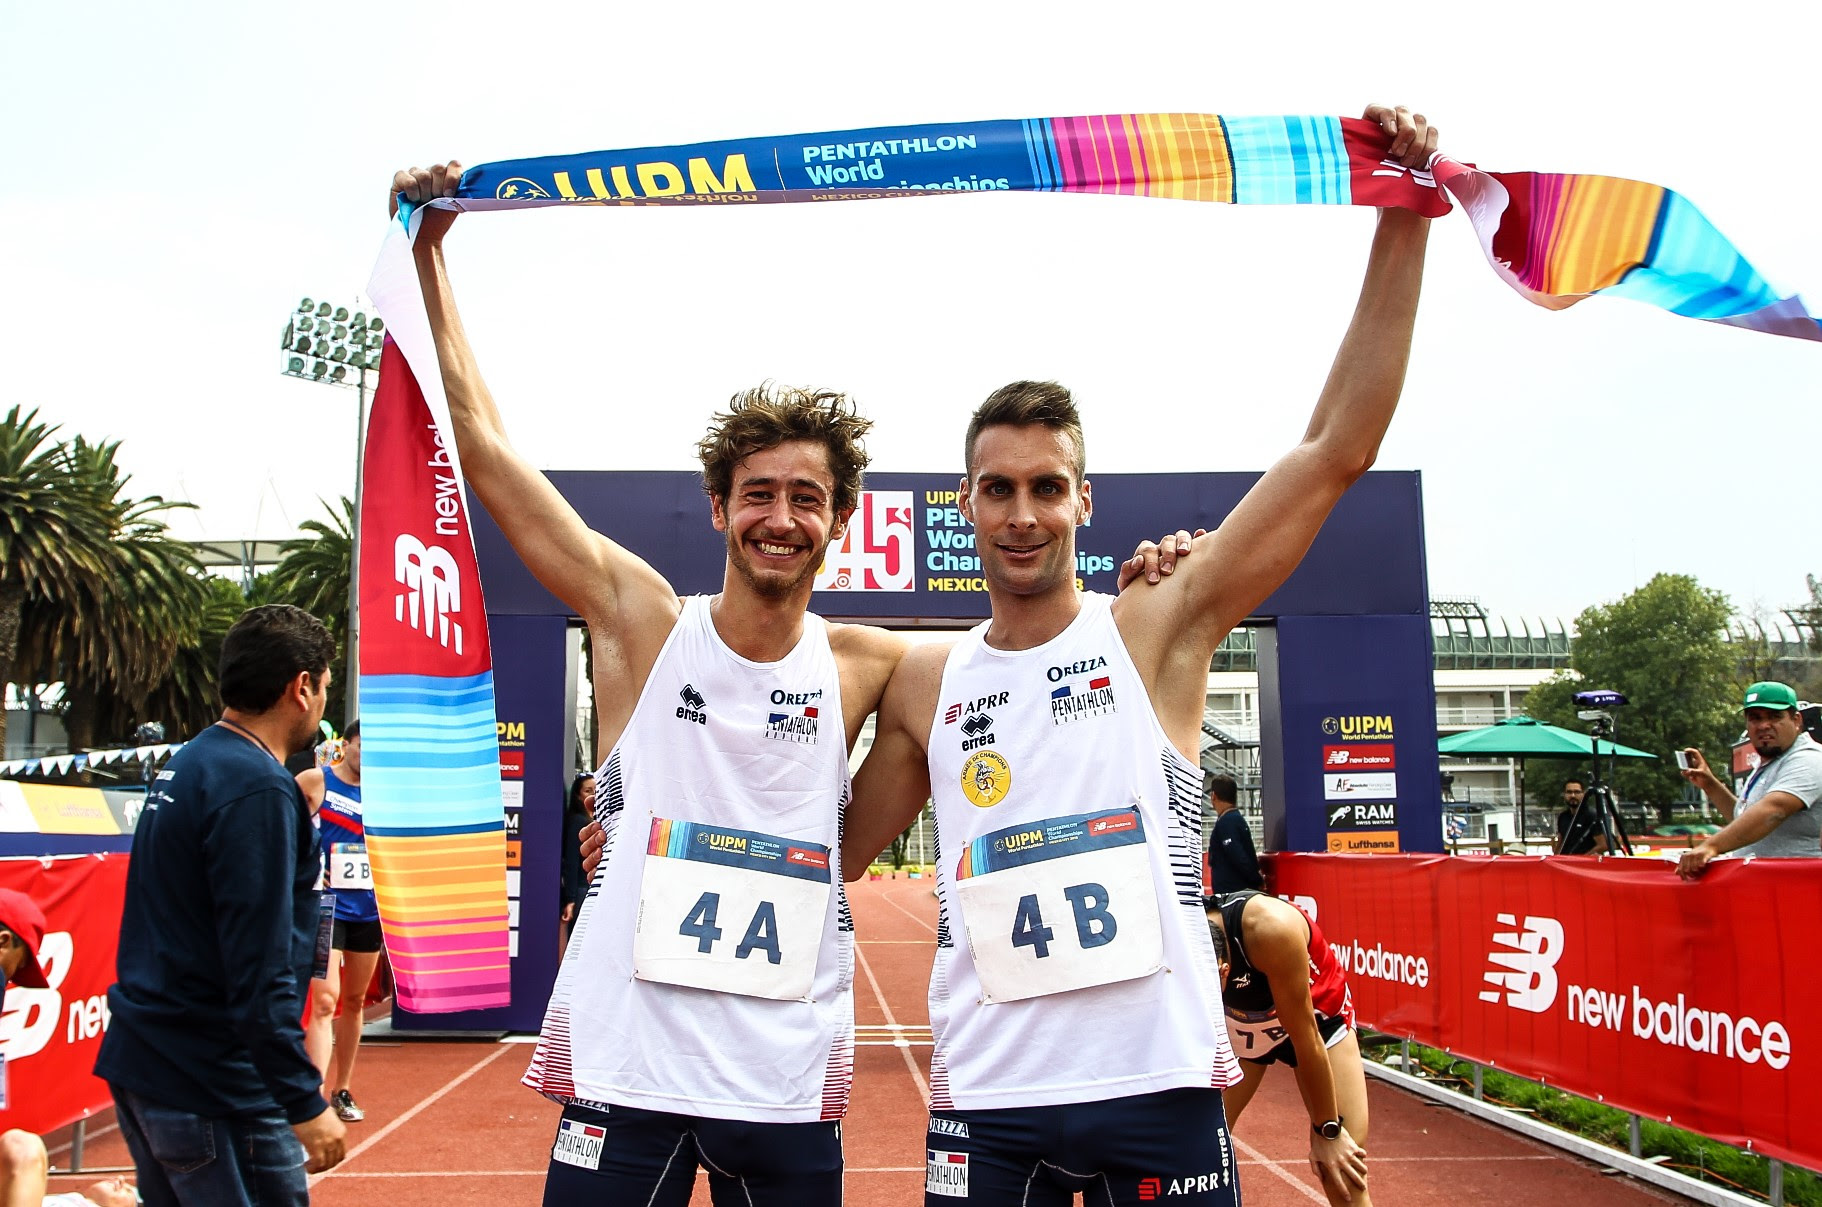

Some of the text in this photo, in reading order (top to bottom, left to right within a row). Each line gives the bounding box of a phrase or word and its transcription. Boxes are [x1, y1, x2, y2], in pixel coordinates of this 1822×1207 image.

[803, 134, 977, 163] PENTATHLON
[805, 158, 884, 186] World
[435, 474, 459, 535] new
[925, 490, 960, 505] UIP
[925, 529, 976, 549] Wor
[1046, 655, 1108, 683] OREZZA
[964, 691, 1010, 716] APRR
[1051, 687, 1115, 718] PENTATHLON
[496, 722, 525, 740] PM
[1340, 715, 1393, 734] UIPM
[961, 733, 995, 751] errea
[979, 752, 1007, 770] CHAMPIONS
[330, 802, 354, 816] System
[1354, 804, 1394, 819] RAM
[709, 834, 747, 850] UIPM
[1004, 830, 1044, 848] UIPM
[1020, 842, 1044, 850] Pentathlon
[1348, 840, 1395, 850] Lufthansa
[722, 846, 746, 854] Pentathlon
[343, 862, 370, 879] 2 B
[679, 891, 722, 954] 4
[735, 901, 782, 965] A
[1012, 894, 1054, 959] 4
[1064, 882, 1118, 950] B
[1354, 938, 1429, 988] balance
[1568, 984, 1626, 1032] new
[1632, 985, 1791, 1070] balance
[1236, 1026, 1288, 1050] 7 B
[1216, 1128, 1229, 1168] errea
[1167, 1172, 1219, 1196] APRR
